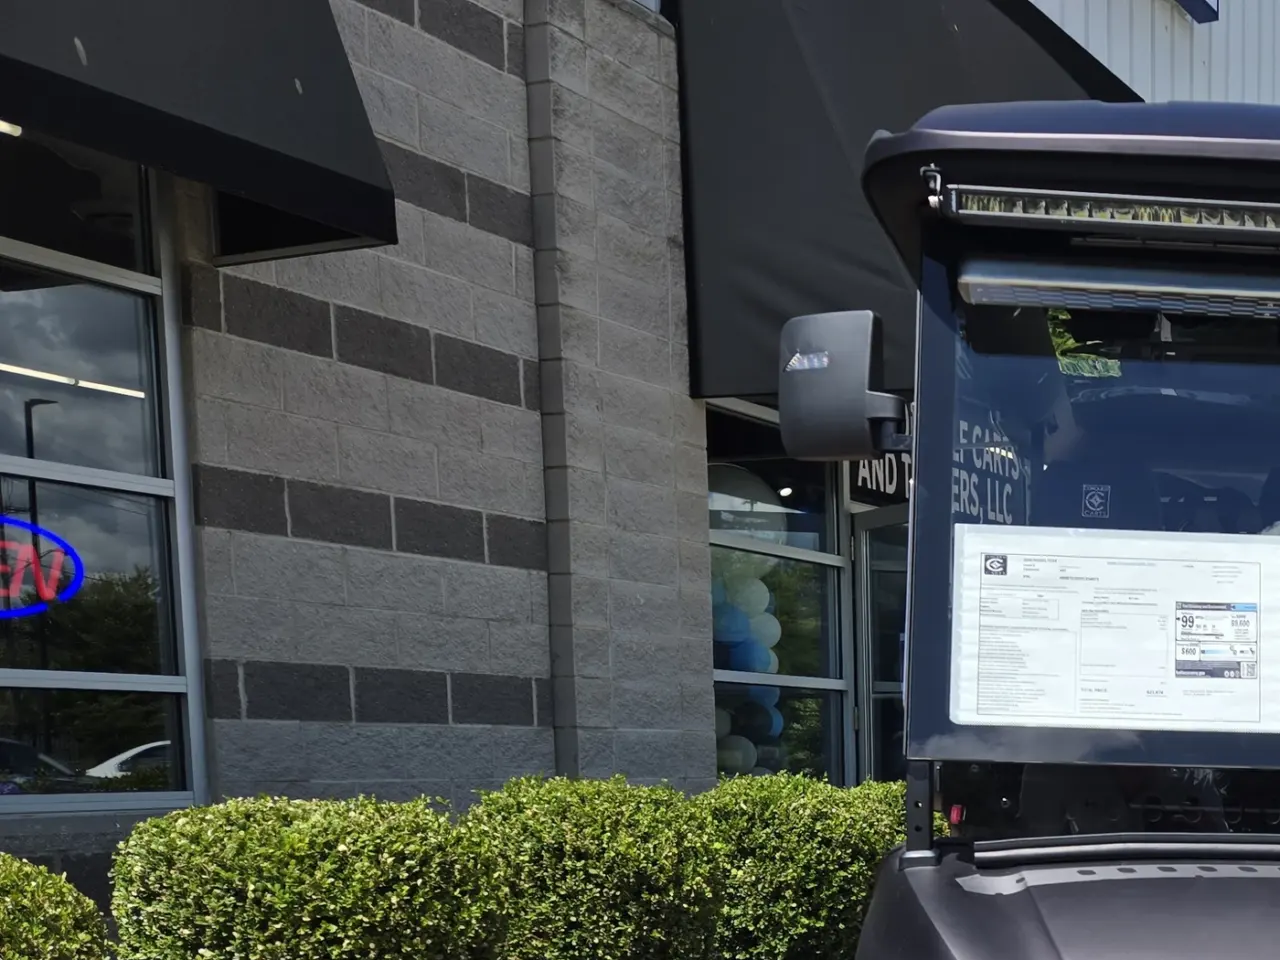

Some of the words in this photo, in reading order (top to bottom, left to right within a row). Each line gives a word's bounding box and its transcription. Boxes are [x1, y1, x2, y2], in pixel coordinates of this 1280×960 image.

[972, 425, 1020, 481] CARTS
[857, 453, 897, 495] AND
[986, 477, 1013, 525] LLC
[1181, 615, 1195, 628] 99
